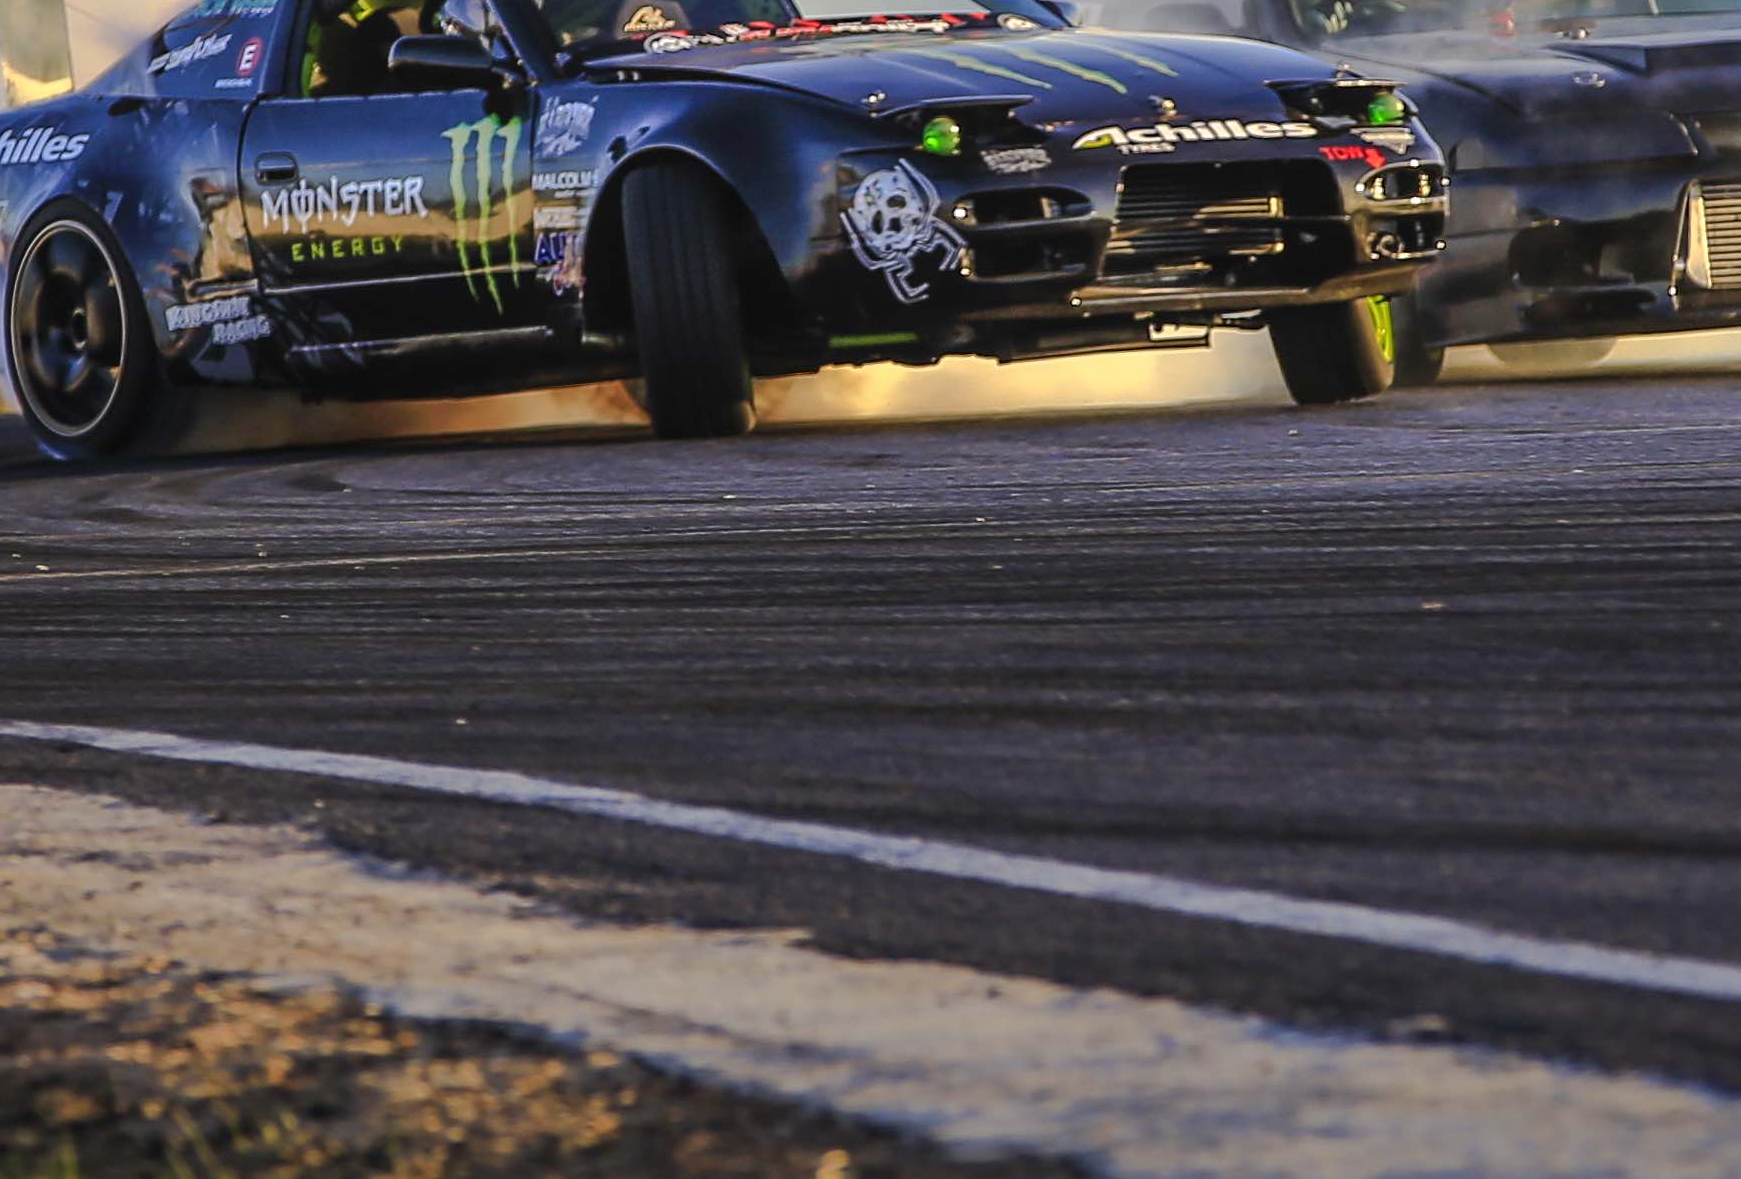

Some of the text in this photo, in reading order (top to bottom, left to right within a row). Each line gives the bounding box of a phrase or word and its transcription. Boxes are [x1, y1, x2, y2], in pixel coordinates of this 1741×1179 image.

[1072, 120, 1318, 149] Achilles
[1117, 143, 1176, 155] TYRES
[260, 174, 430, 235] MONSTER
[291, 235, 403, 261] ENERGY
